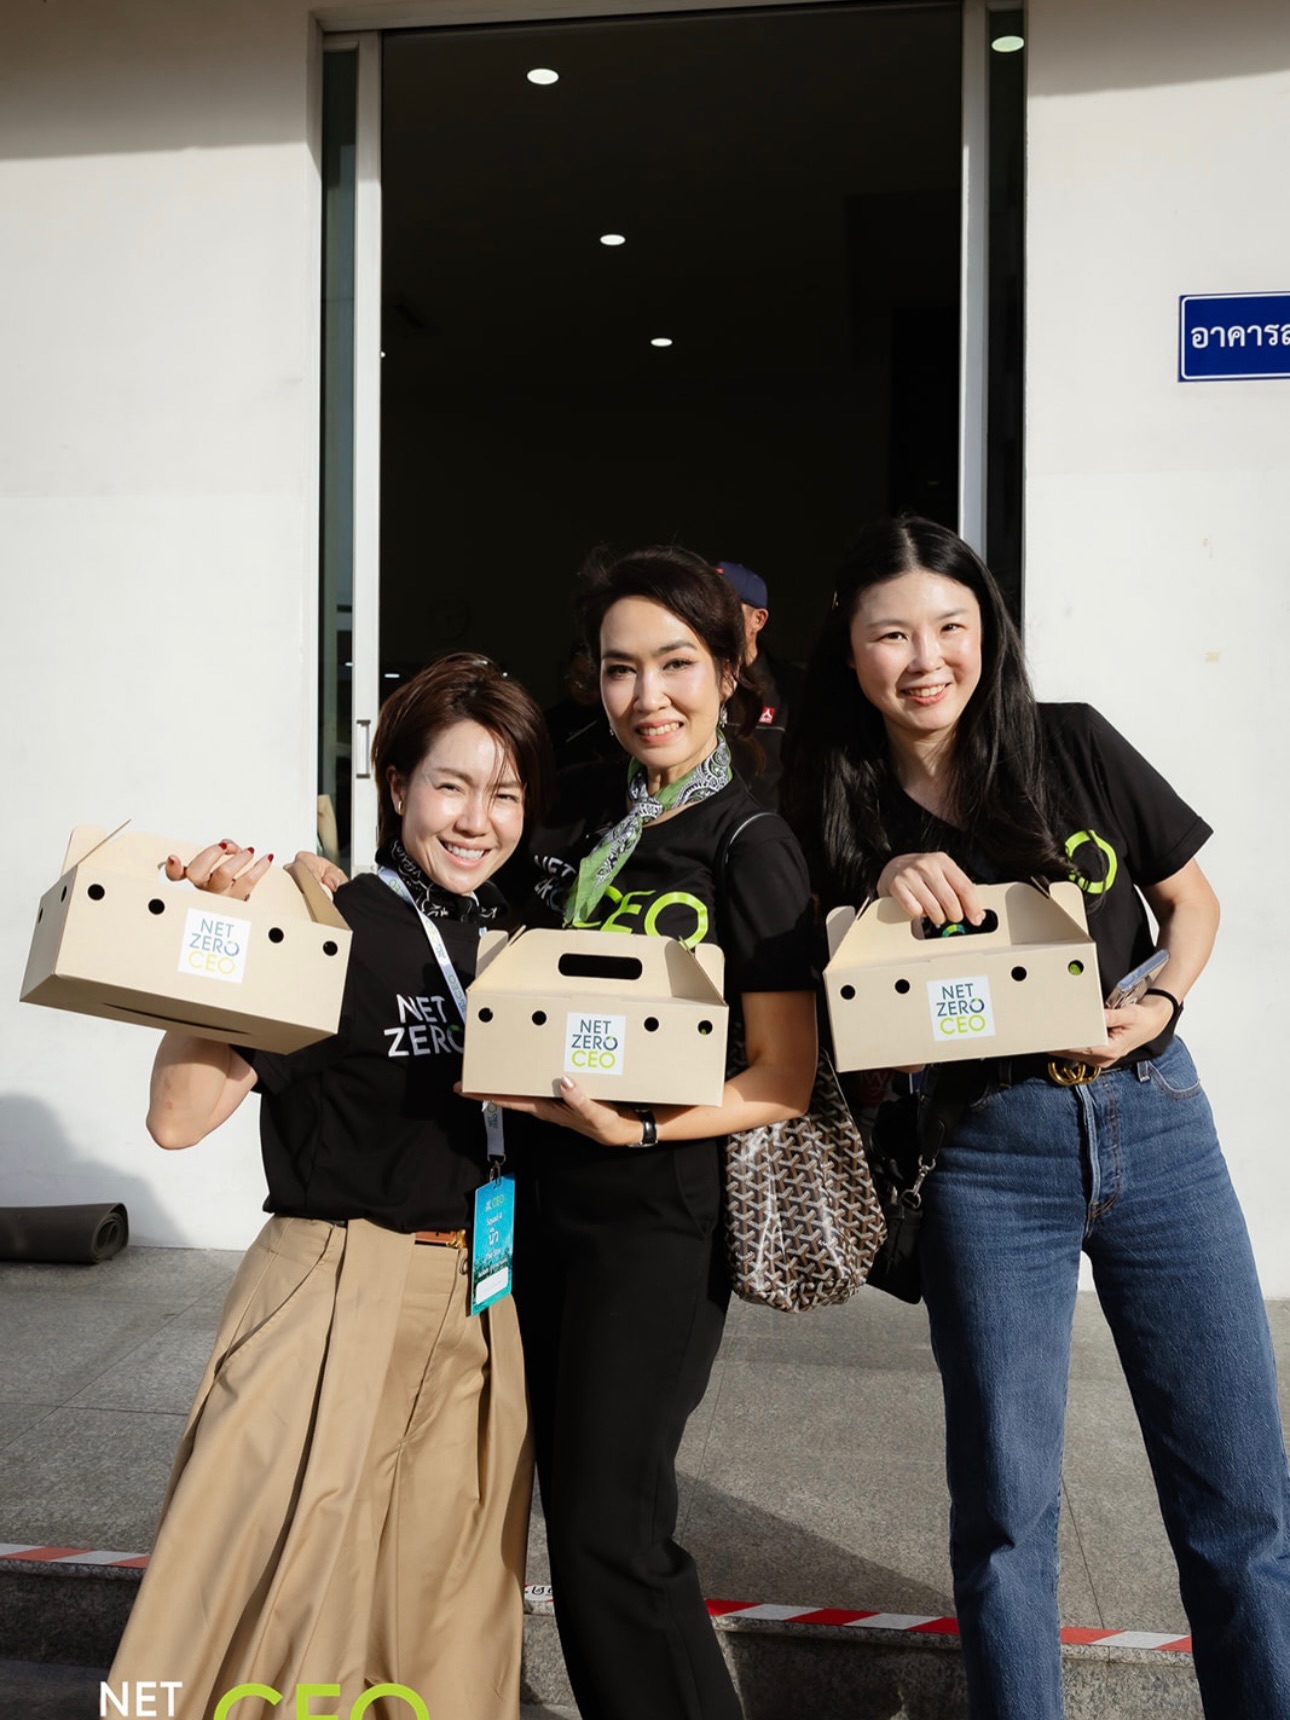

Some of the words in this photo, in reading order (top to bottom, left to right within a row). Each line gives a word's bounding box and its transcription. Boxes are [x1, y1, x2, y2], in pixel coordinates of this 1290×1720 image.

[200, 918, 235, 938] NET
[188, 932, 240, 957] ZERO
[188, 949, 236, 975] CEO
[942, 982, 974, 1000] NET
[396, 993, 447, 1024] NET
[936, 997, 985, 1017] ZERO
[579, 1019, 612, 1034] NET
[939, 1014, 986, 1036] CEO
[571, 1033, 618, 1051] ZERO
[571, 1049, 616, 1069] CEO
